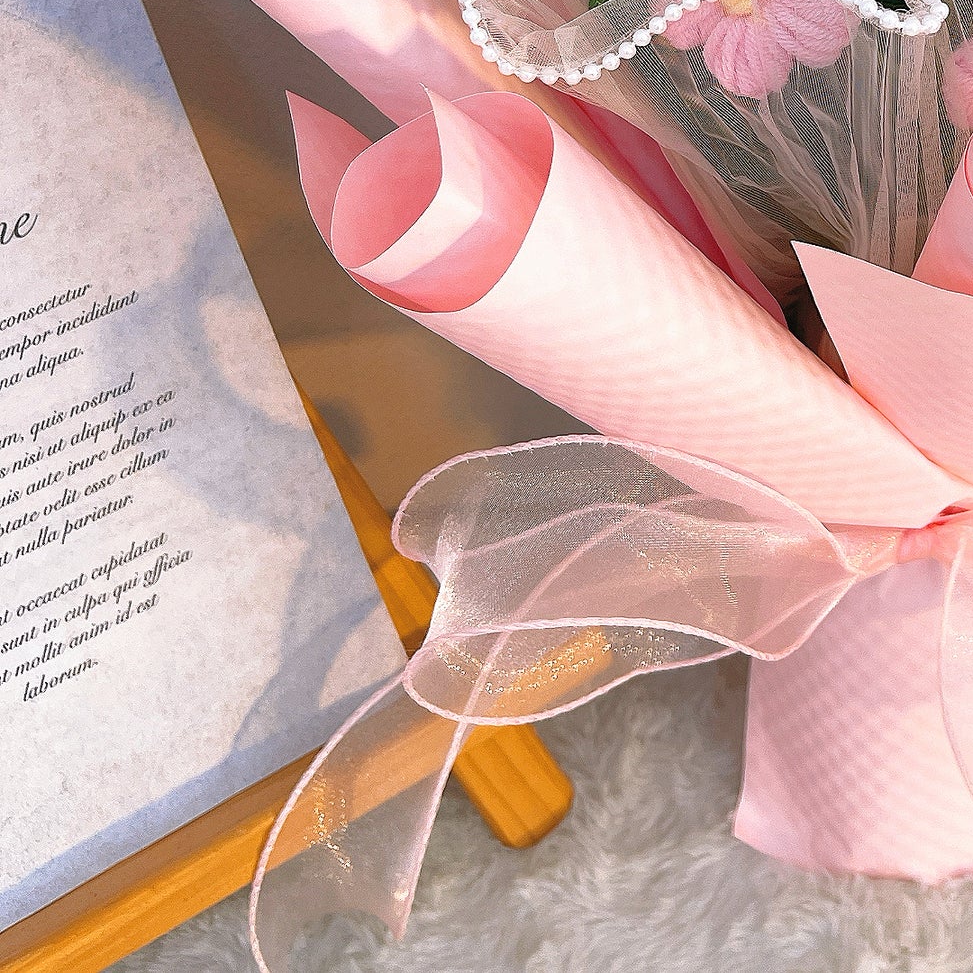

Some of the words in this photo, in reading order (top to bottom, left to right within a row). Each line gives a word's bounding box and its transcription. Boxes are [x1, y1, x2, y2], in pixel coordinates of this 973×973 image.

[0, 284, 92, 331] consectetur
[56, 290, 139, 336] incididunt
[26, 346, 84, 376] aliqua.
[0, 433, 24, 449] m,
[30, 410, 68, 442] quis
[69, 371, 135, 418] nostrud
[12, 446, 46, 473] nisi
[47, 438, 68, 457] ut
[70, 409, 129, 446] aliquip
[156, 390, 176, 406] ea
[26, 470, 64, 496] aute
[67, 450, 109, 476] irure
[111, 427, 156, 456] dolor
[159, 417, 177, 433] in
[43, 488, 81, 516] velit
[84, 473, 117, 496] esse
[119, 449, 170, 479] cillum
[15, 526, 60, 559] nulla
[61, 494, 134, 545] pariatur.
[91, 532, 168, 581] cupidatat
[0, 626, 41, 654] sunt
[43, 617, 62, 634] in
[64, 593, 111, 621] culpa
[113, 571, 142, 604] qui
[143, 549, 193, 588] officia
[15, 641, 67, 677] mollit
[69, 620, 114, 649] anim
[115, 600, 135, 625] id
[136, 593, 161, 614] est
[23, 658, 99, 702] laborum.
